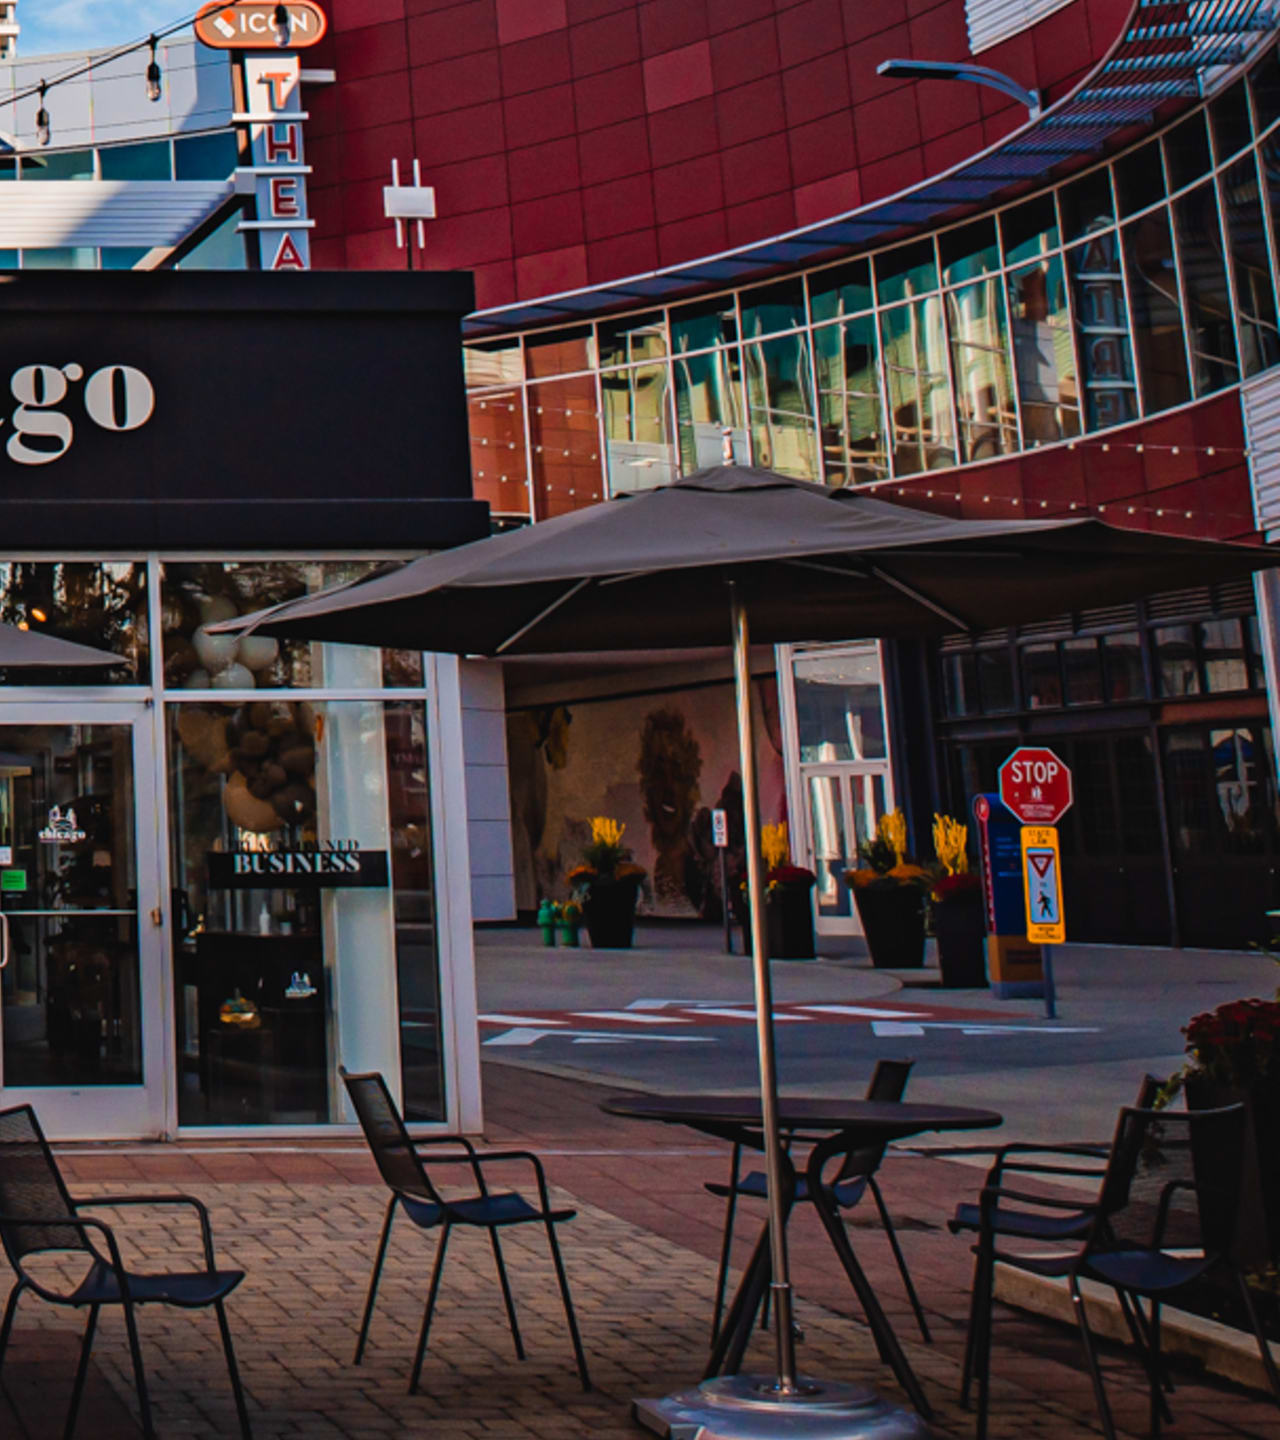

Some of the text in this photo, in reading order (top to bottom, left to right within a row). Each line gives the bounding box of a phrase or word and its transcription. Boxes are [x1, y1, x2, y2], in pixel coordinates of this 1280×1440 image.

[1011, 761, 1059, 784] STOP
[38, 826, 86, 843] chicago
[233, 852, 361, 874] BUSINESS
